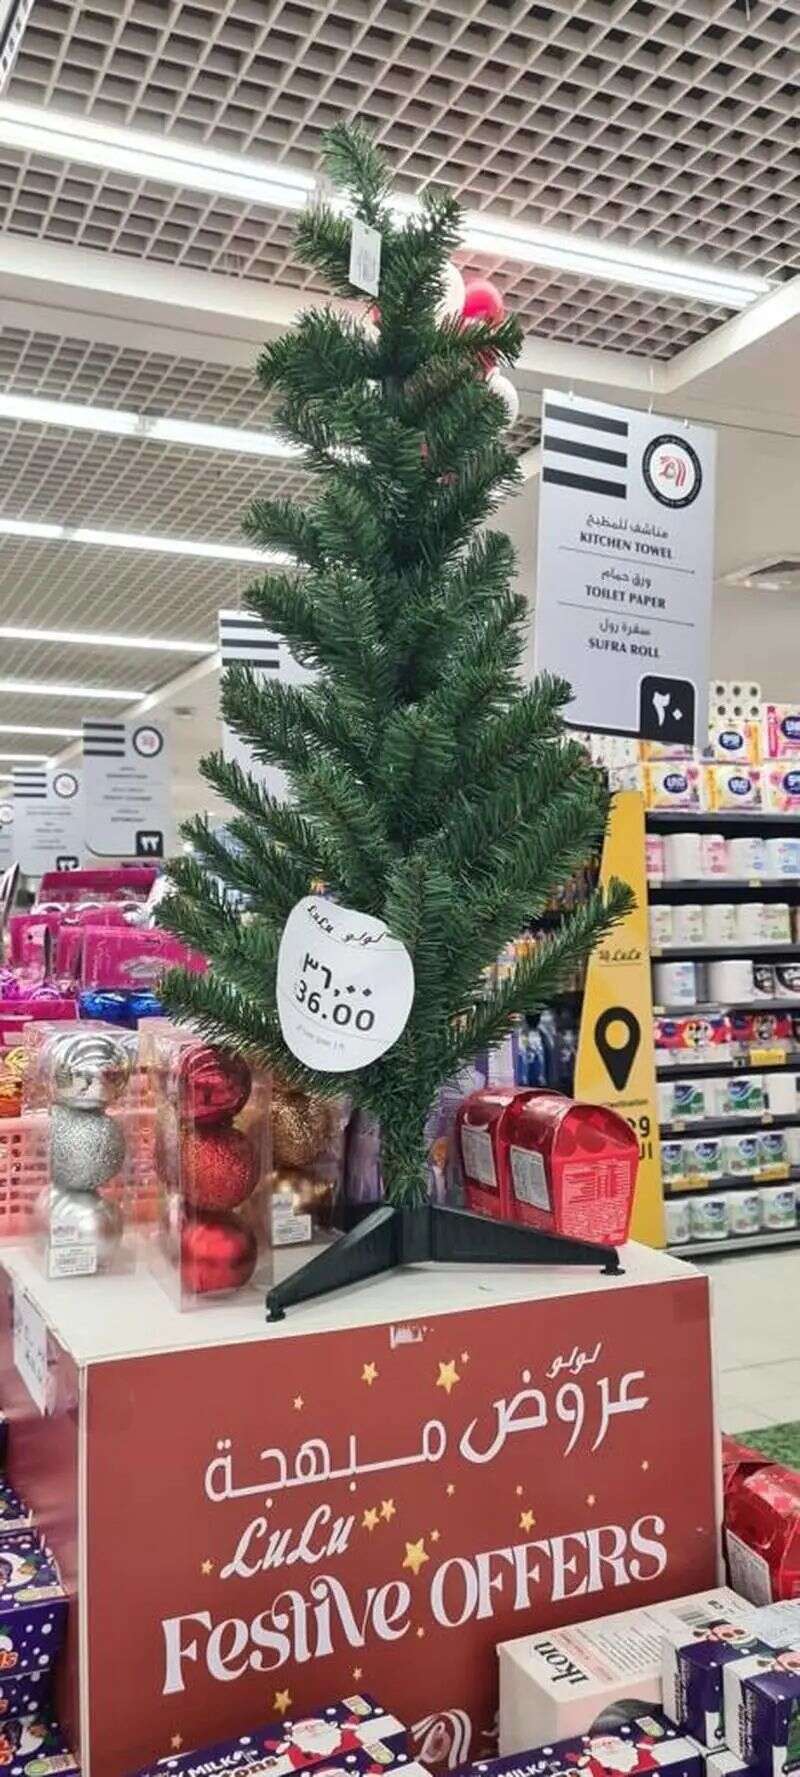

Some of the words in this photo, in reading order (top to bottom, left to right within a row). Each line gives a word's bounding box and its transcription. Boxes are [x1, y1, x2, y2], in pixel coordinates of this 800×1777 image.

[580, 531, 631, 551] KITCHEN
[635, 542, 673, 559] TOWEL
[601, 567, 629, 582] حمام
[632, 572, 652, 589] ورق
[585, 584, 626, 602] TOILET
[629, 593, 666, 609] PAPER
[600, 617, 619, 634] رول
[622, 623, 651, 636] سفرة
[588, 637, 627, 653] SUFRA
[630, 644, 660, 659] ROLL
[652, 690, 684, 727] ٢٠
[307, 904, 334, 934] LuLu
[344, 931, 387, 946] لولو
[295, 979, 375, 1032] 36.00
[546, 1342, 602, 1380] لولو
[458, 1369, 650, 1465] عروض
[204, 1418, 448, 1509] مبهجة
[219, 1503, 356, 1581] LuLu
[430, 1514, 668, 1629] OFFERS
